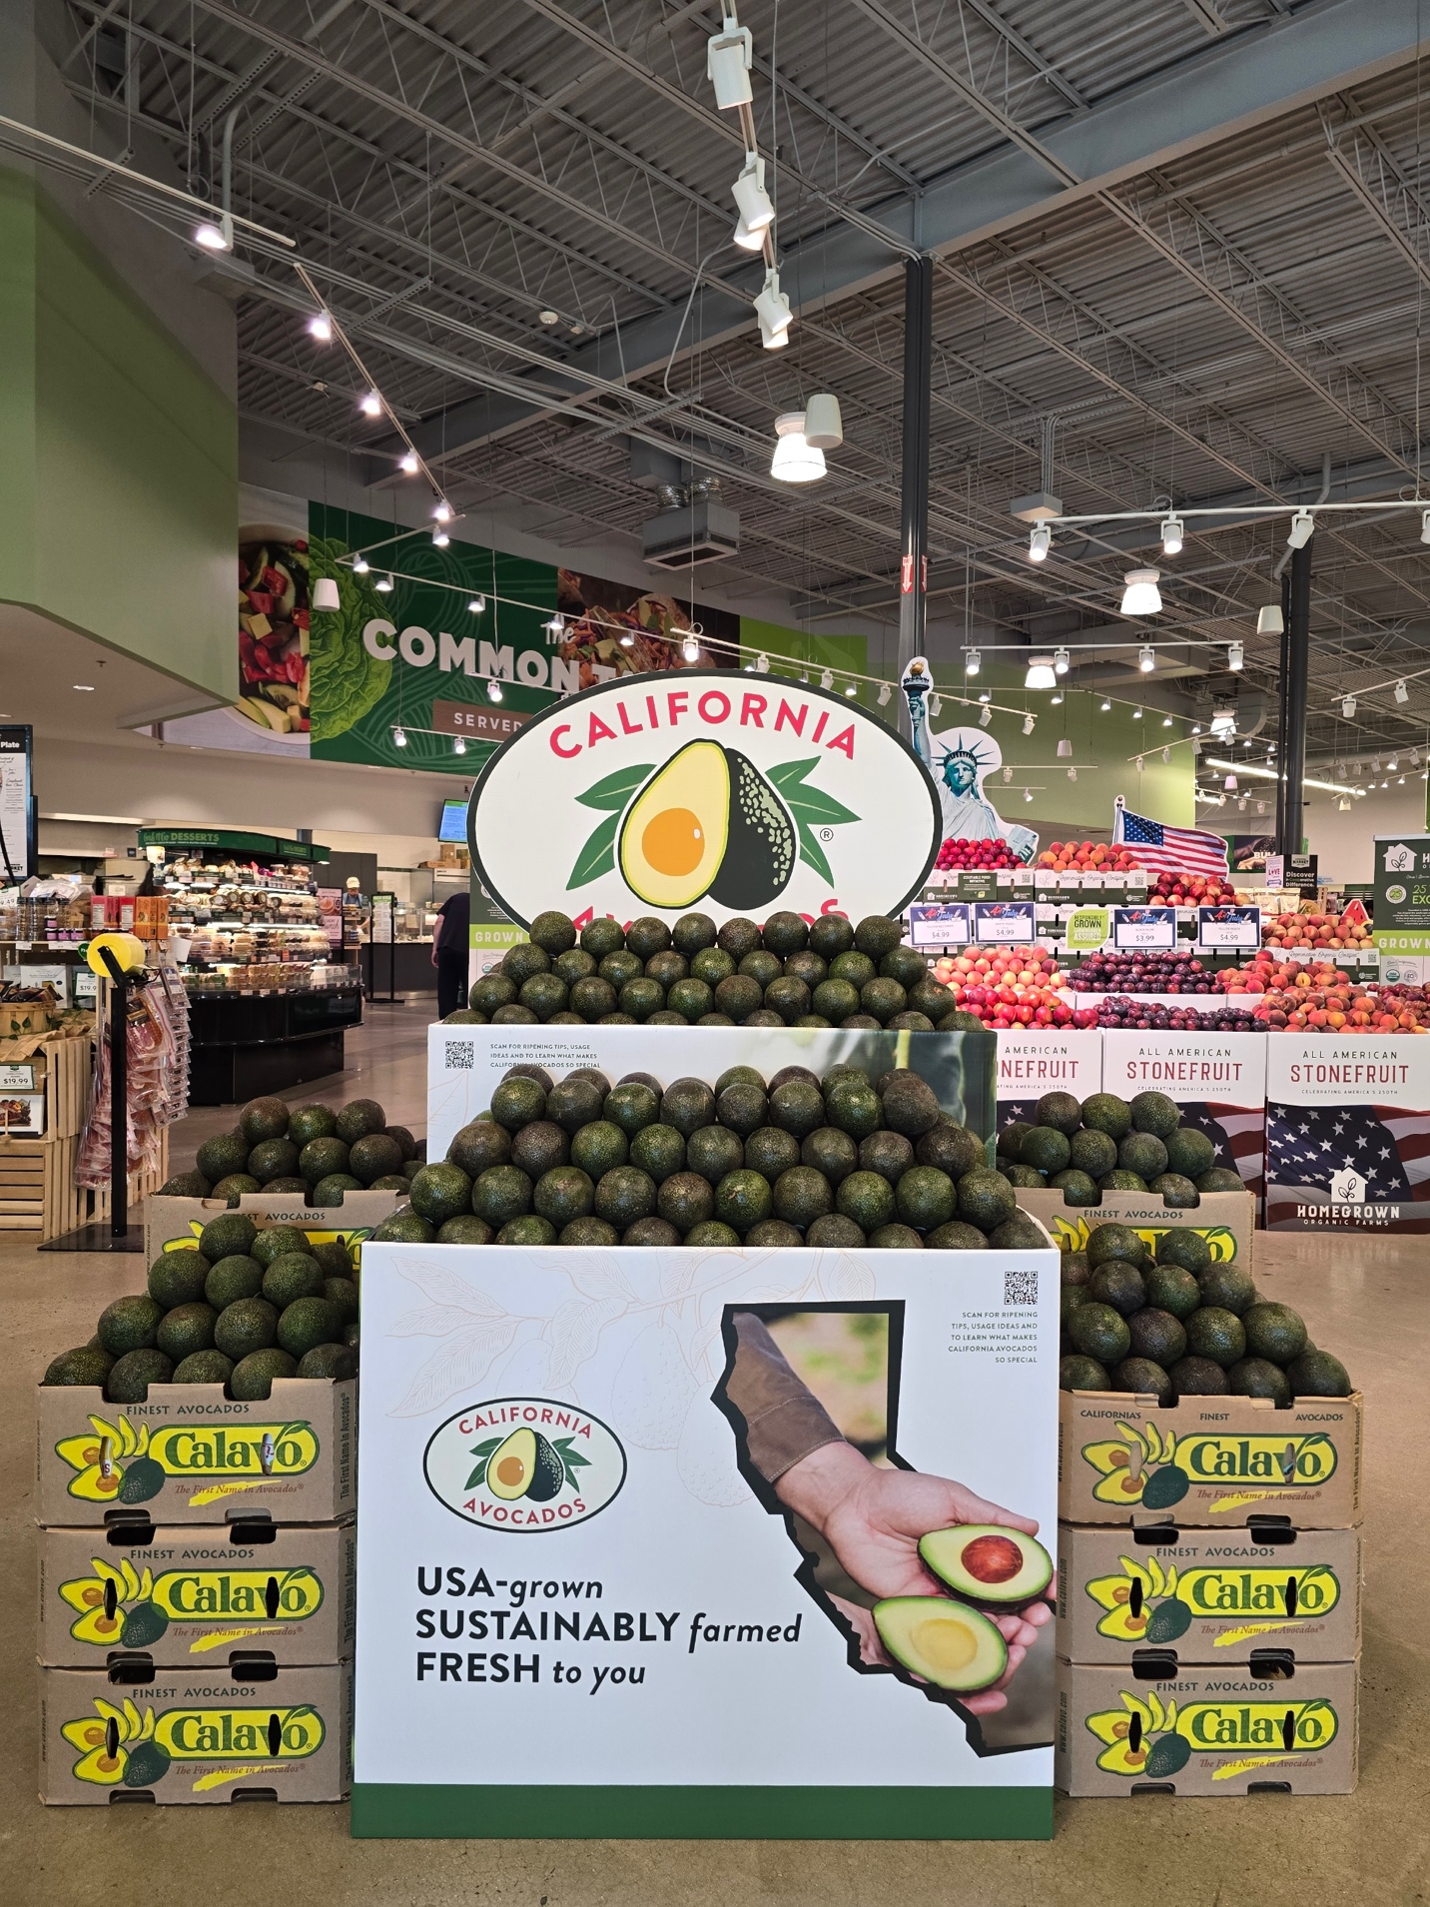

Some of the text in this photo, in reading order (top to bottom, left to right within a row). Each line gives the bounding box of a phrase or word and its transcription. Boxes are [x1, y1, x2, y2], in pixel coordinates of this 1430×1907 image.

[540, 616, 575, 645] The
[363, 618, 579, 694] COMMON
[549, 690, 856, 761] CALIFORNIA
[170, 833, 220, 842] DESSERTS
[1074, 920, 1102, 928] GROWN
[475, 931, 523, 943] GROWN
[1004, 1046, 1068, 1055] AMERICAN
[1139, 1048, 1232, 1057] ALL AMERICAN
[1302, 1051, 1397, 1060] ALL AMERICAN
[995, 1060, 1079, 1079] NEFRUIT
[1127, 1061, 1242, 1081] STONEFRUIT
[1290, 1064, 1409, 1083] STONEFRUIT
[265, 1212, 326, 1221] AVOCADOS
[1084, 1210, 1183, 1219] FINEST AVOCADOS
[1297, 1205, 1400, 1218] HOMEGROWN
[126, 1404, 250, 1415] FINEST AVOCADOS
[1080, 1409, 1343, 1421] CALIFORNIA'S FINEST AVOCADOS
[458, 1407, 592, 1440] CALIFORNIA
[174, 1484, 190, 1494] The
[192, 1484, 214, 1494] First
[215, 1484, 242, 1494] Name
[244, 1484, 254, 1494] in
[1196, 1490, 1212, 1499] The
[1213, 1490, 1235, 1500] First
[1237, 1491, 1263, 1500] Name
[1264, 1490, 1275, 1500] in
[463, 1497, 587, 1525] AVOCADOS
[130, 1549, 254, 1559] FINEST AVOCADOS
[1156, 1547, 1275, 1557] FINEST AVOCADOS
[417, 1566, 603, 1608] USA-grown
[1058, 1558, 1067, 1619] www.calavo.com
[172, 1627, 191, 1637] The
[192, 1627, 215, 1637] First
[216, 1627, 243, 1637] Name
[244, 1627, 255, 1637] in
[415, 1609, 802, 1653] SUSTAINABLY farmed
[1200, 1624, 1218, 1634] The
[1219, 1624, 1241, 1634] First
[1242, 1625, 1268, 1634] Name
[1269, 1624, 1278, 1634] in
[416, 1652, 646, 1695] FRESH to you
[132, 1687, 256, 1698] FINEST AVOCADOS
[1156, 1682, 1274, 1692] FINEST AVOCADOS
[1058, 1691, 1068, 1754] www.calavo.com
[1199, 1758, 1217, 1768] The
[1218, 1758, 1240, 1768] First
[1241, 1759, 1266, 1768] Name
[1268, 1758, 1277, 1768] in
[174, 1765, 193, 1774] The
[194, 1765, 217, 1774] First
[218, 1765, 245, 1774] Name
[246, 1765, 256, 1774] in
